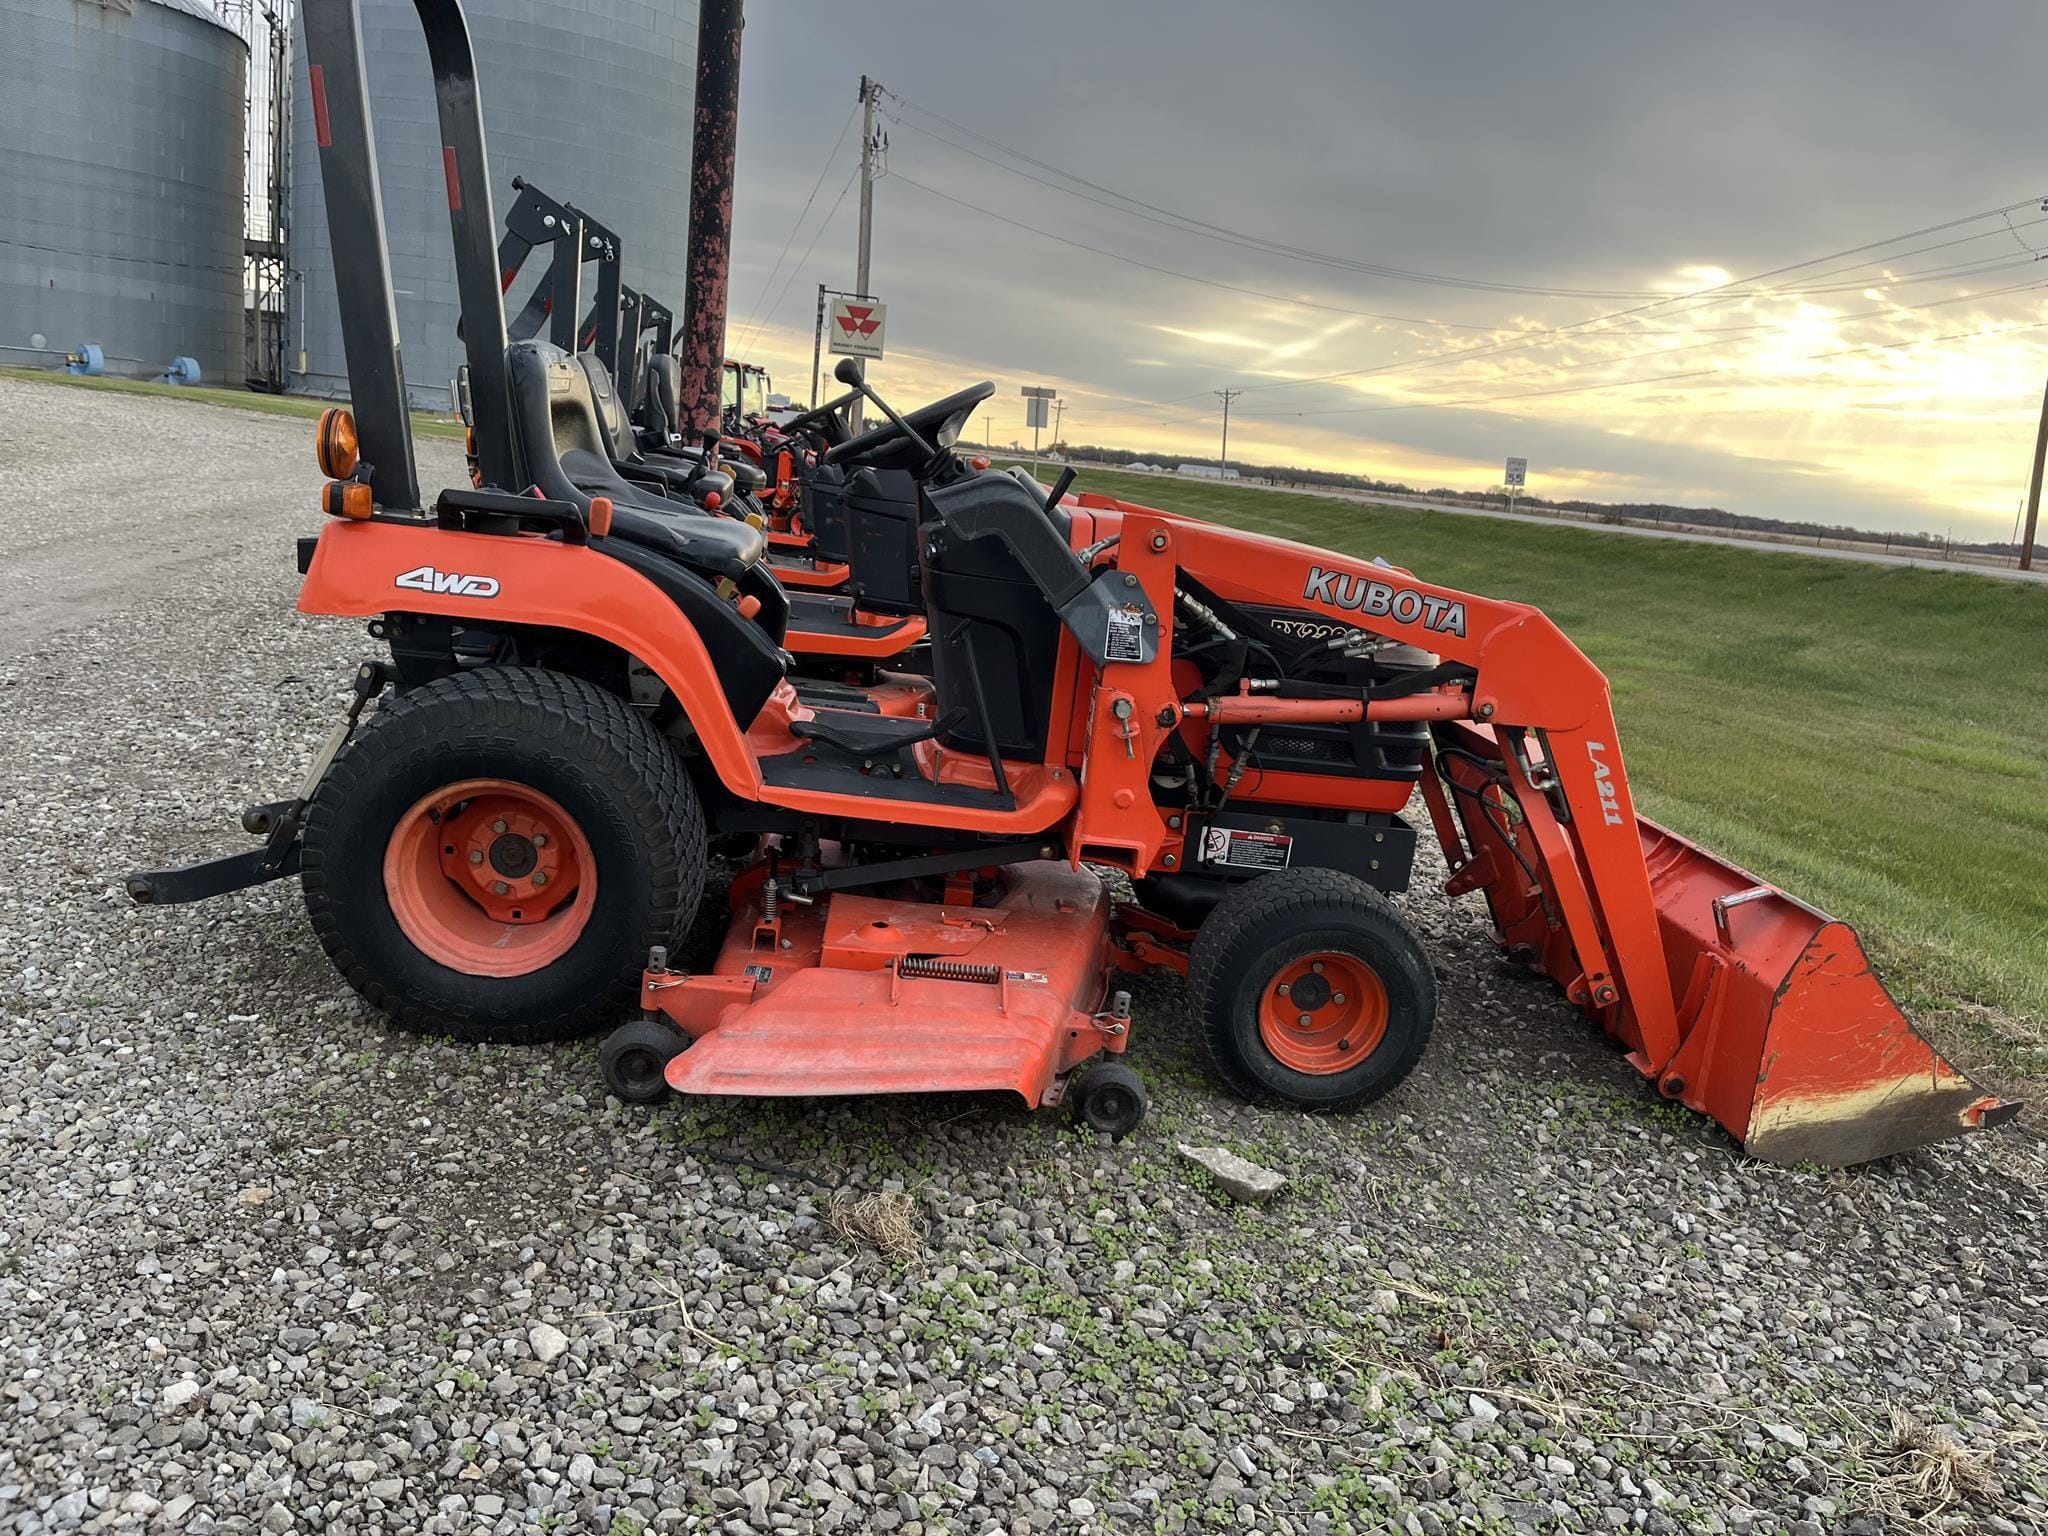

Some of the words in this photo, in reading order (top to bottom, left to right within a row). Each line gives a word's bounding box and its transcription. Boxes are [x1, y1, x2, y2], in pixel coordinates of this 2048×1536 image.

[1508, 473, 1523, 484] 55
[395, 566, 500, 598] 4WD
[1303, 566, 1467, 639] KUBOTA
[1586, 741, 1624, 826] LA211
[1253, 834, 1274, 842] DANGER
